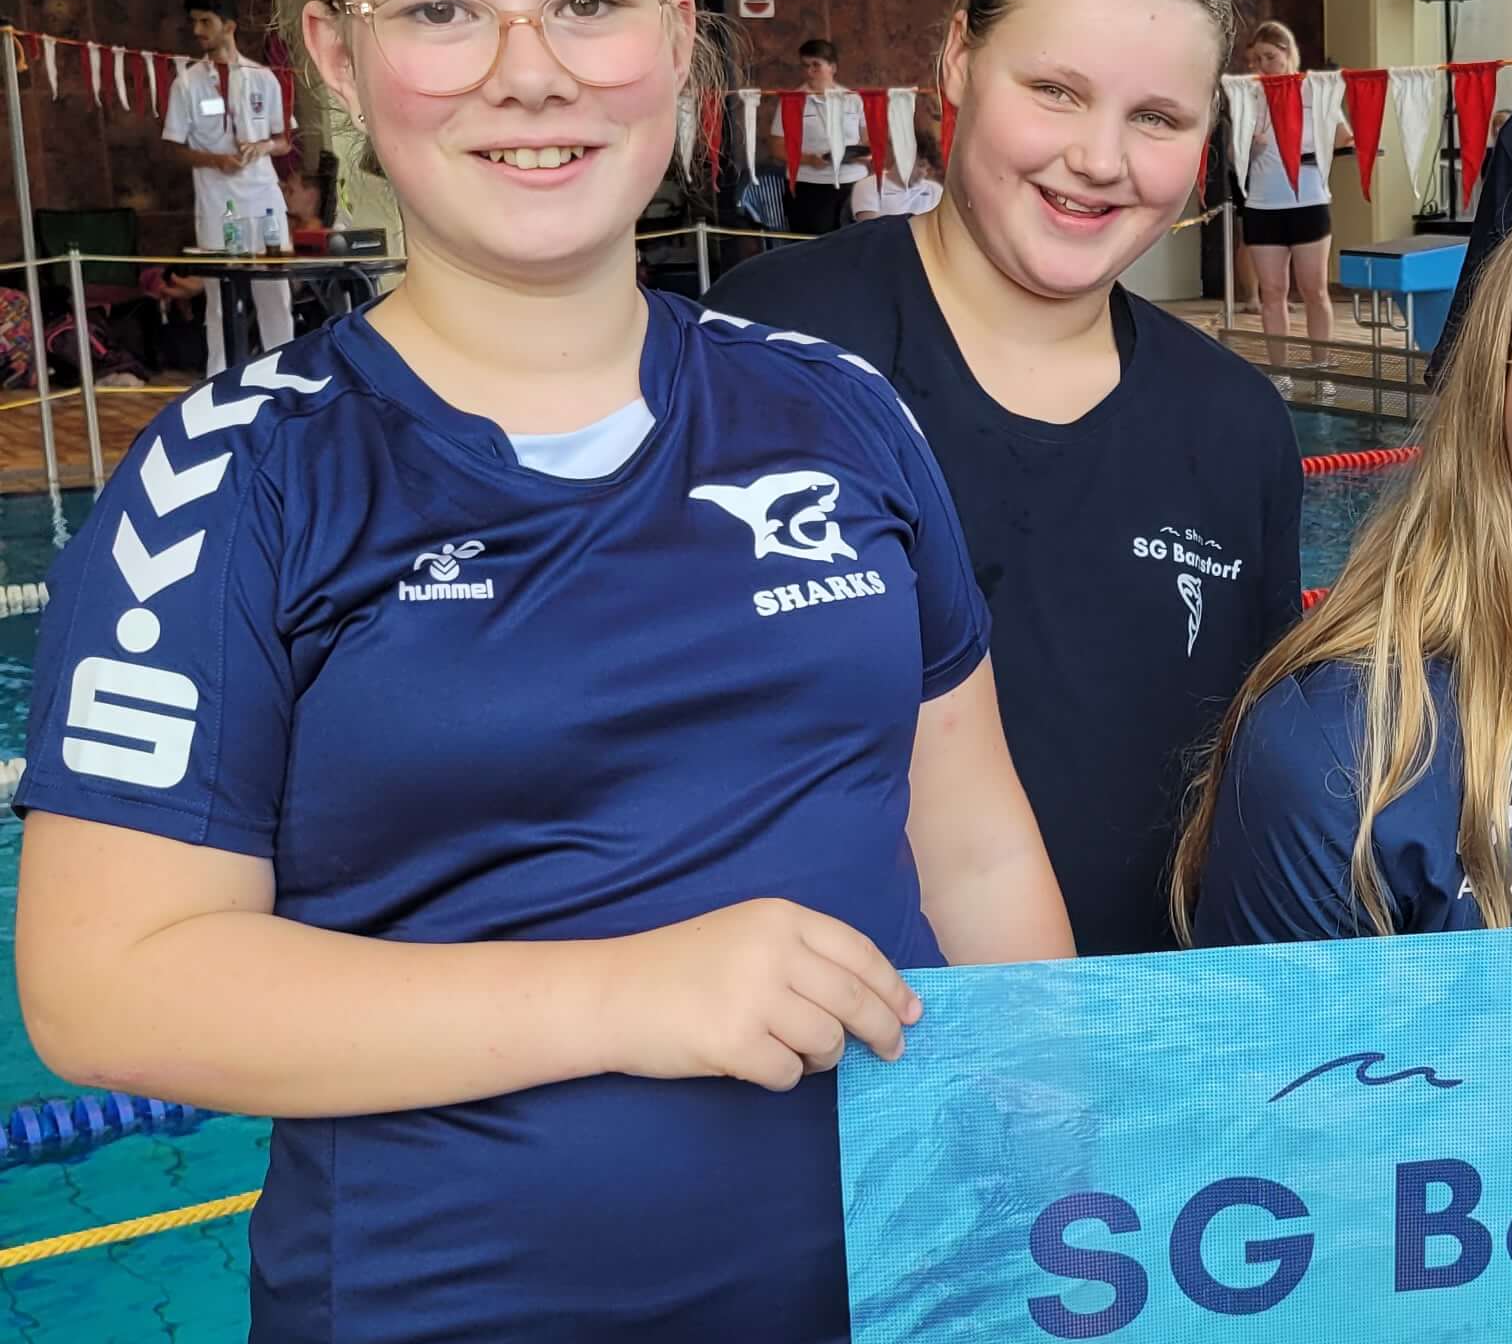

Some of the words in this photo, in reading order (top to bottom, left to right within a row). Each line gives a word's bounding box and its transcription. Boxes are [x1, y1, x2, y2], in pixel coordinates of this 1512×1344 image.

[1133, 536, 1168, 560] SG
[399, 578, 494, 601] hummel
[753, 570, 886, 617] SHARKS
[1026, 1174, 1317, 1342] SG
